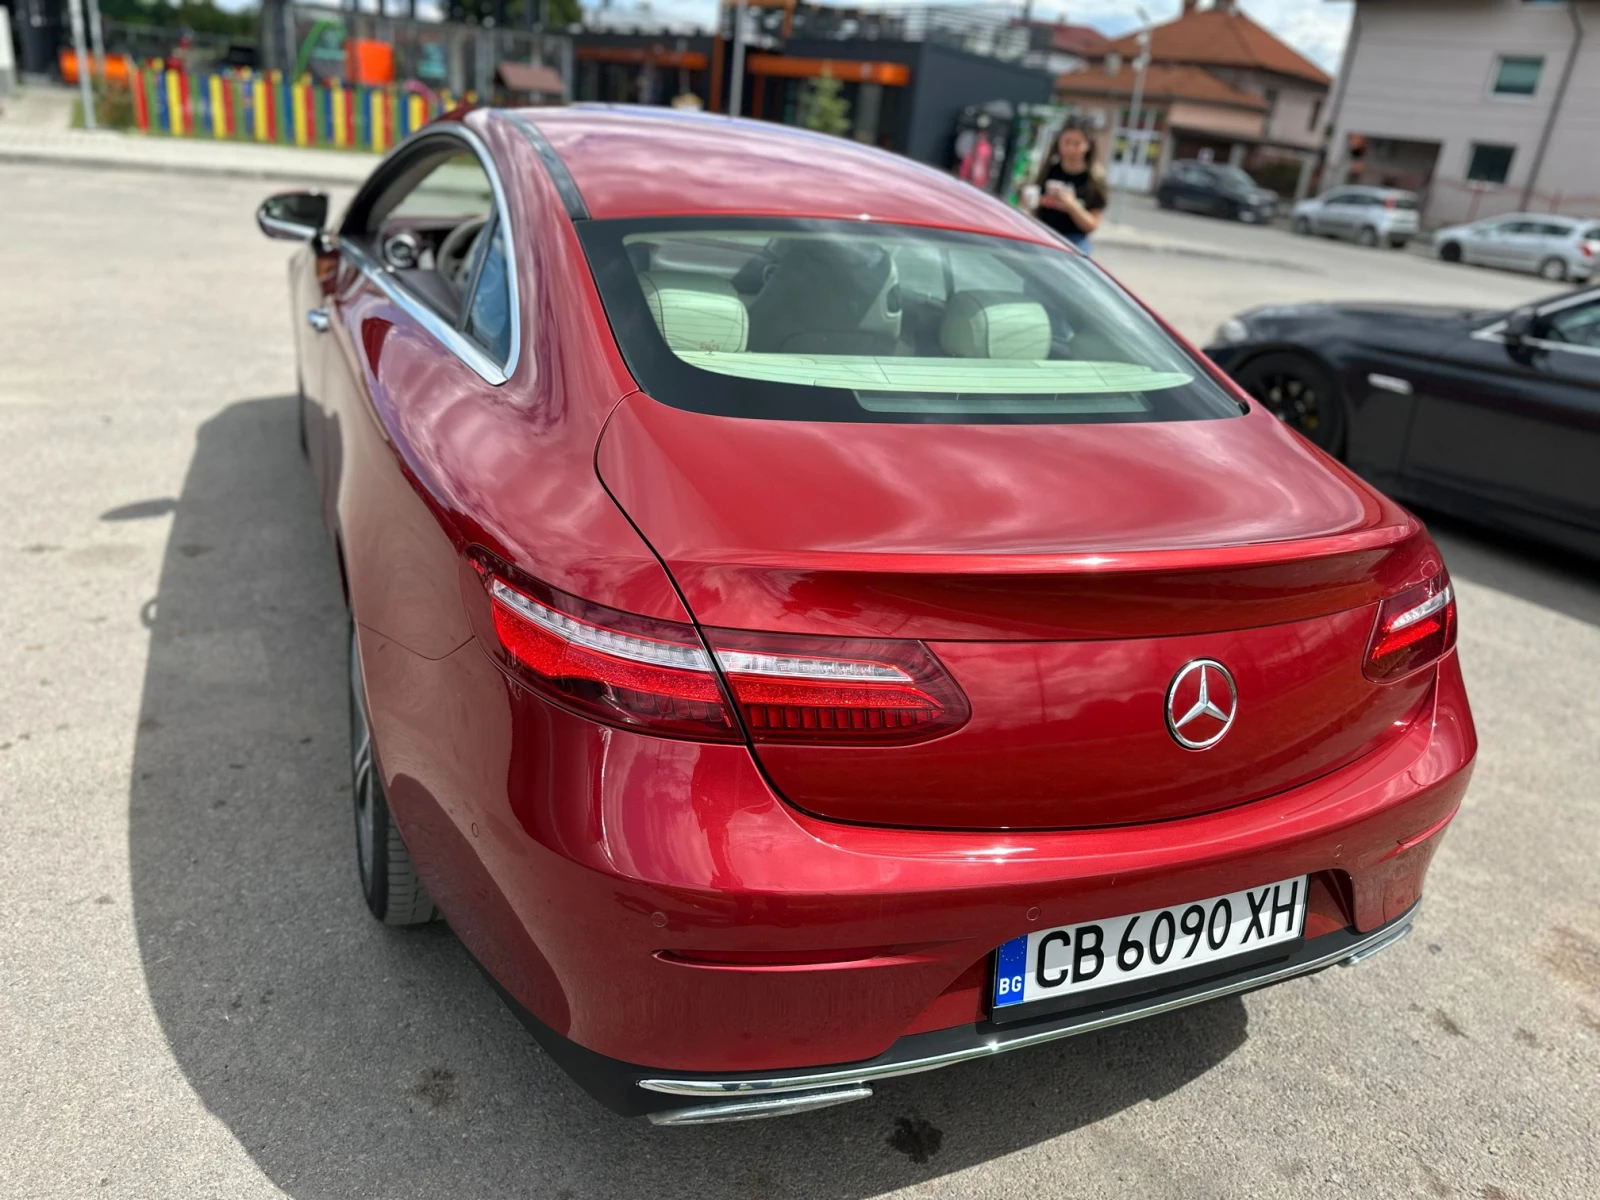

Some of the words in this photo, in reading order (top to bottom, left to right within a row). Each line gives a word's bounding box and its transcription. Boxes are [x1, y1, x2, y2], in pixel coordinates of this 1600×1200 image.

[1036, 925, 1105, 988] CB
[1117, 898, 1232, 972] 6090
[1240, 881, 1299, 944] XH
[999, 976, 1022, 995] BG
